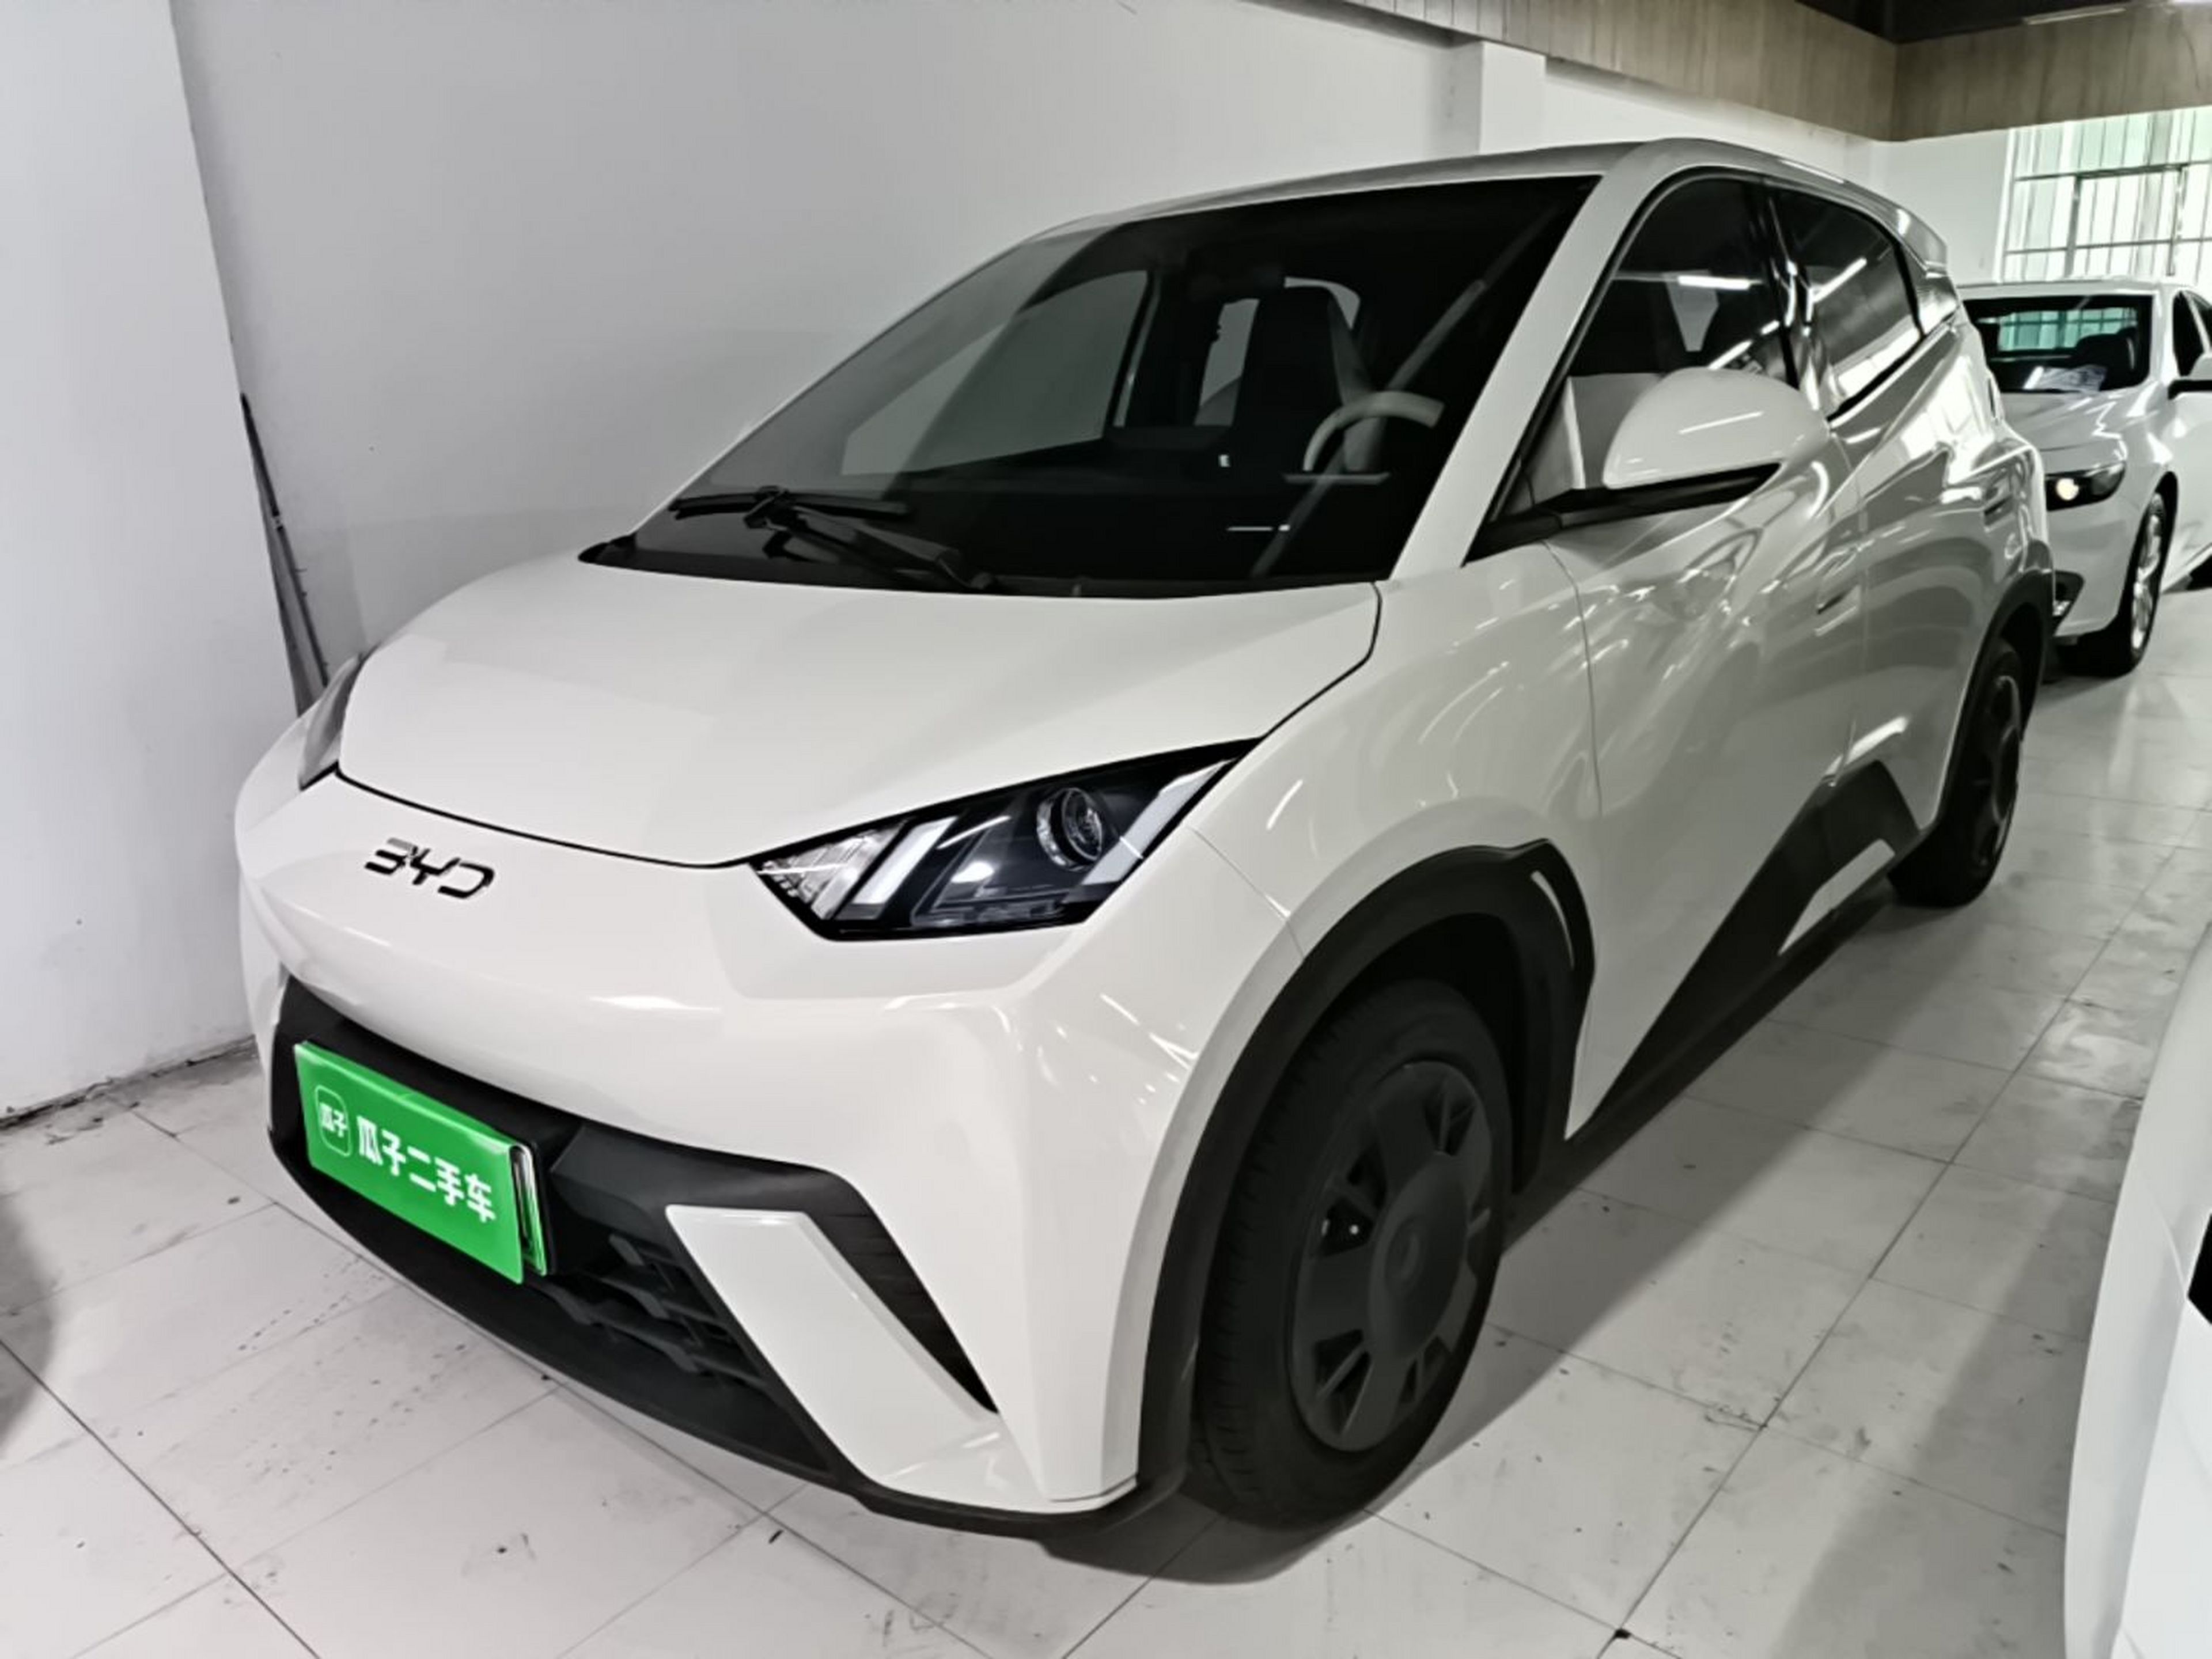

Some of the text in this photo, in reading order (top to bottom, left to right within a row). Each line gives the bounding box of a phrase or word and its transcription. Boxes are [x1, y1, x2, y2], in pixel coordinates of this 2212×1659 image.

[364, 838, 495, 899] BYD
[319, 1102, 348, 1138] 瓜子
[357, 1115, 496, 1223] 瓜子二手车
